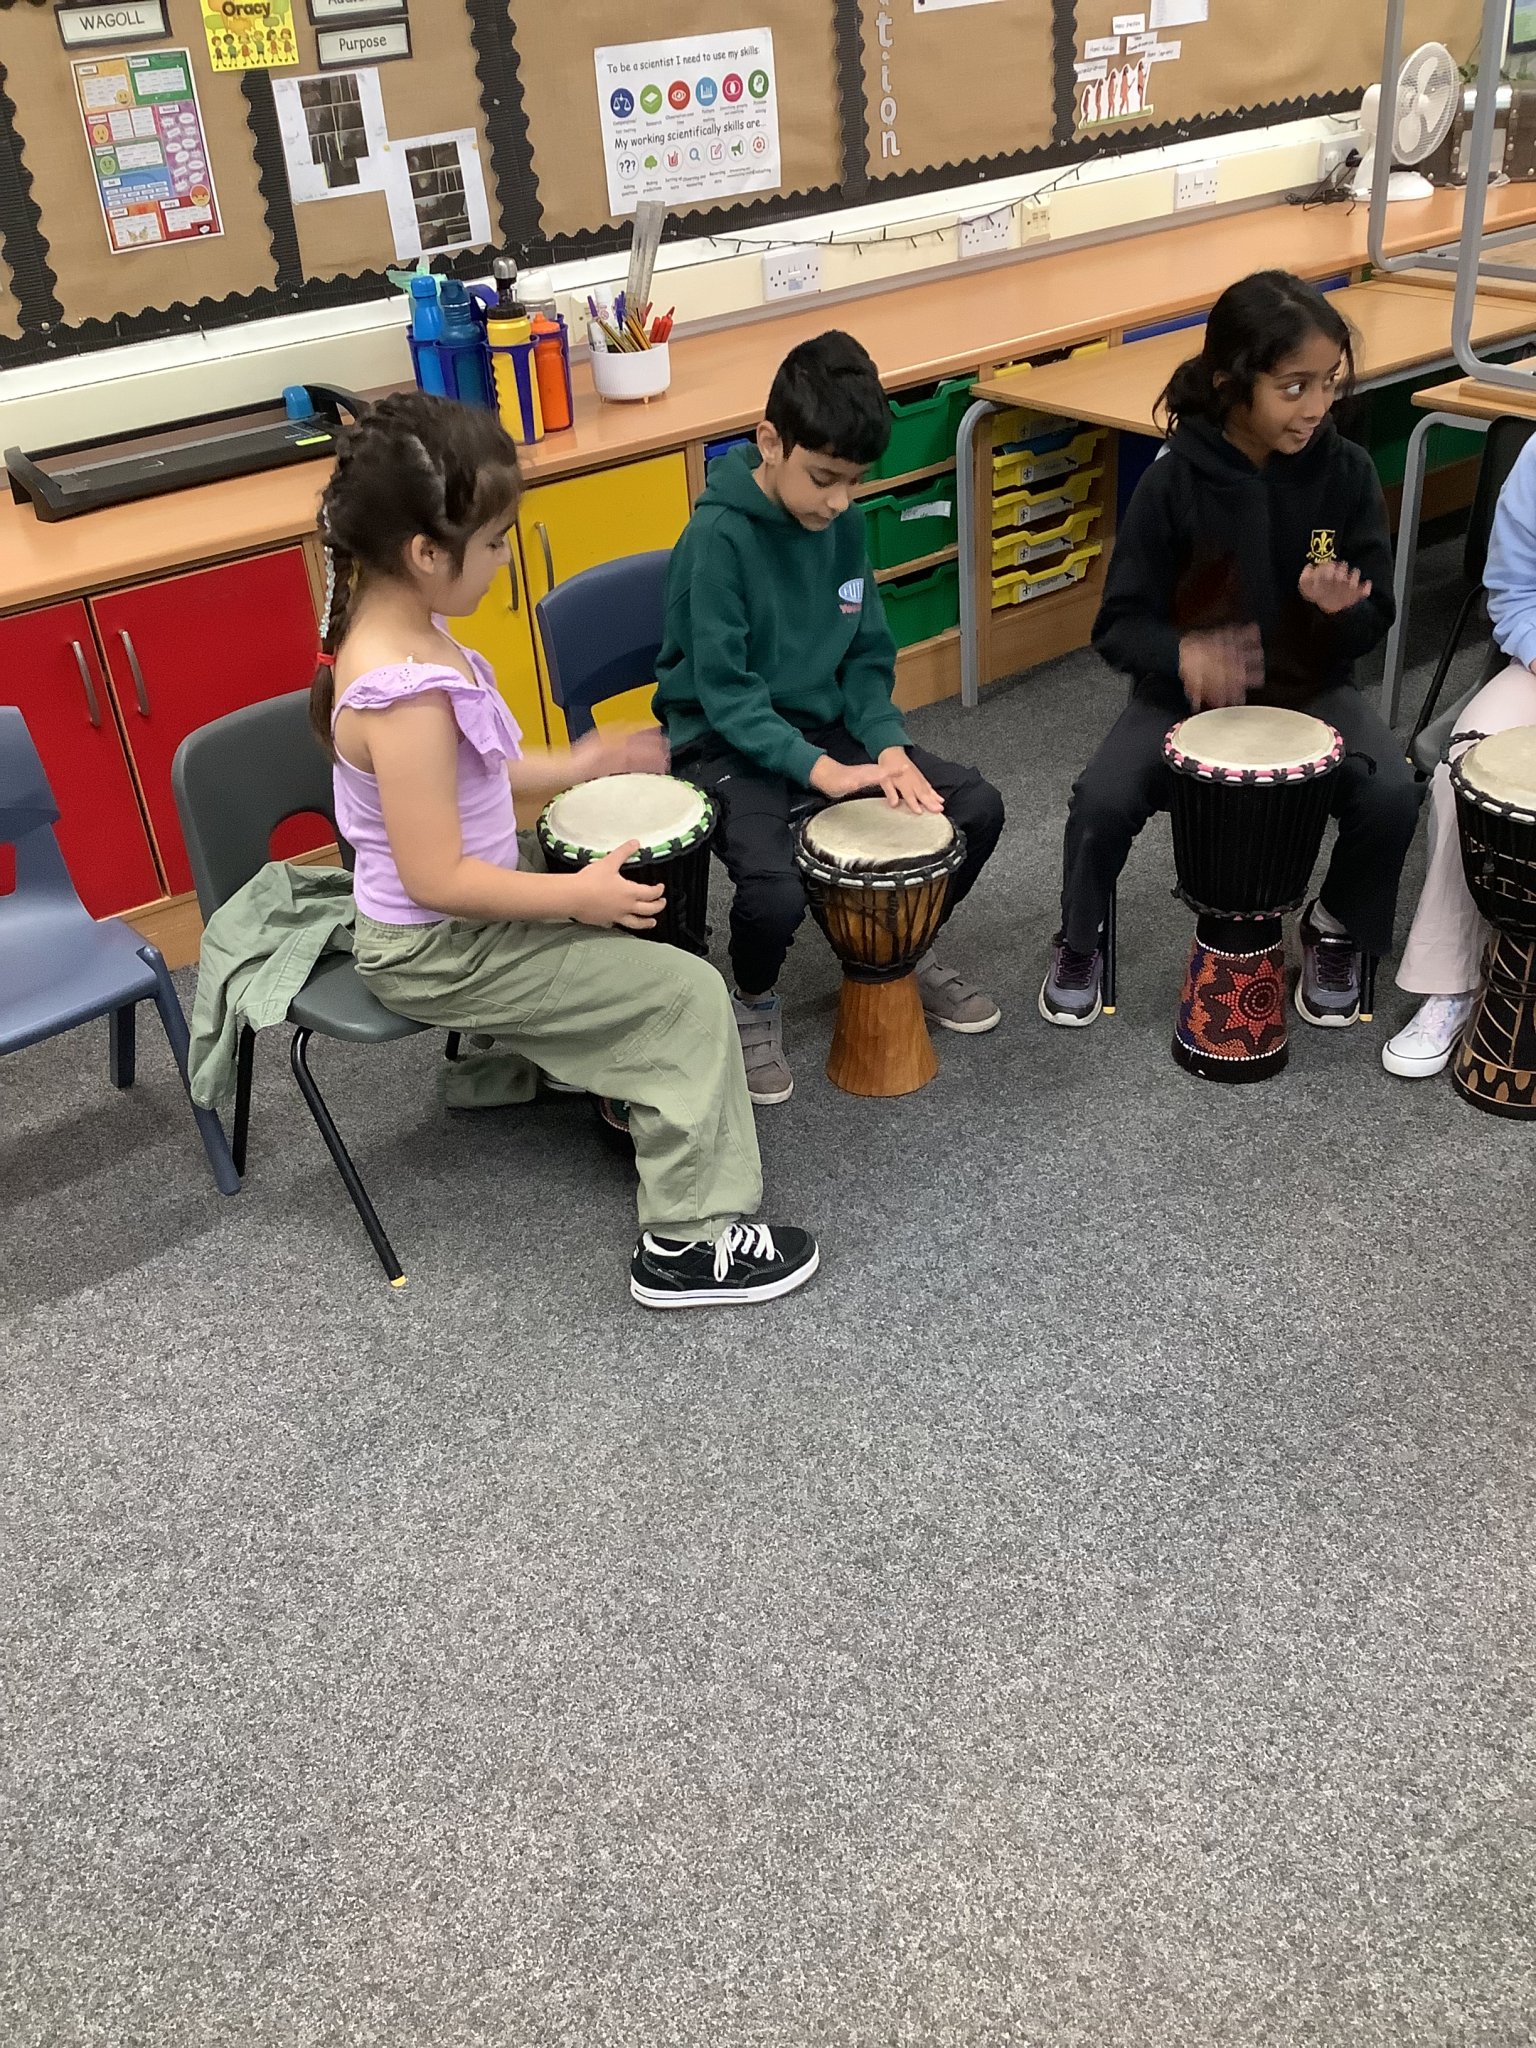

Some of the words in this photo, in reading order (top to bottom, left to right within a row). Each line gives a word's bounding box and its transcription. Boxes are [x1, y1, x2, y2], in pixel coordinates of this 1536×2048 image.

[79, 9, 145, 31] WAGOLL
[221, 0, 271, 19] Oracy
[338, 33, 388, 54] Purpose
[607, 63, 618, 74] To
[620, 62, 631, 73] be
[640, 56, 674, 70] scientist
[676, 55, 681, 65] I
[683, 54, 701, 65] need
[703, 52, 711, 62] to
[713, 51, 726, 61] use
[728, 50, 738, 60] my
[614, 138, 629, 151] My
[631, 133, 665, 147] working
[667, 122, 722, 142] scientifically
[724, 121, 744, 133] skills
